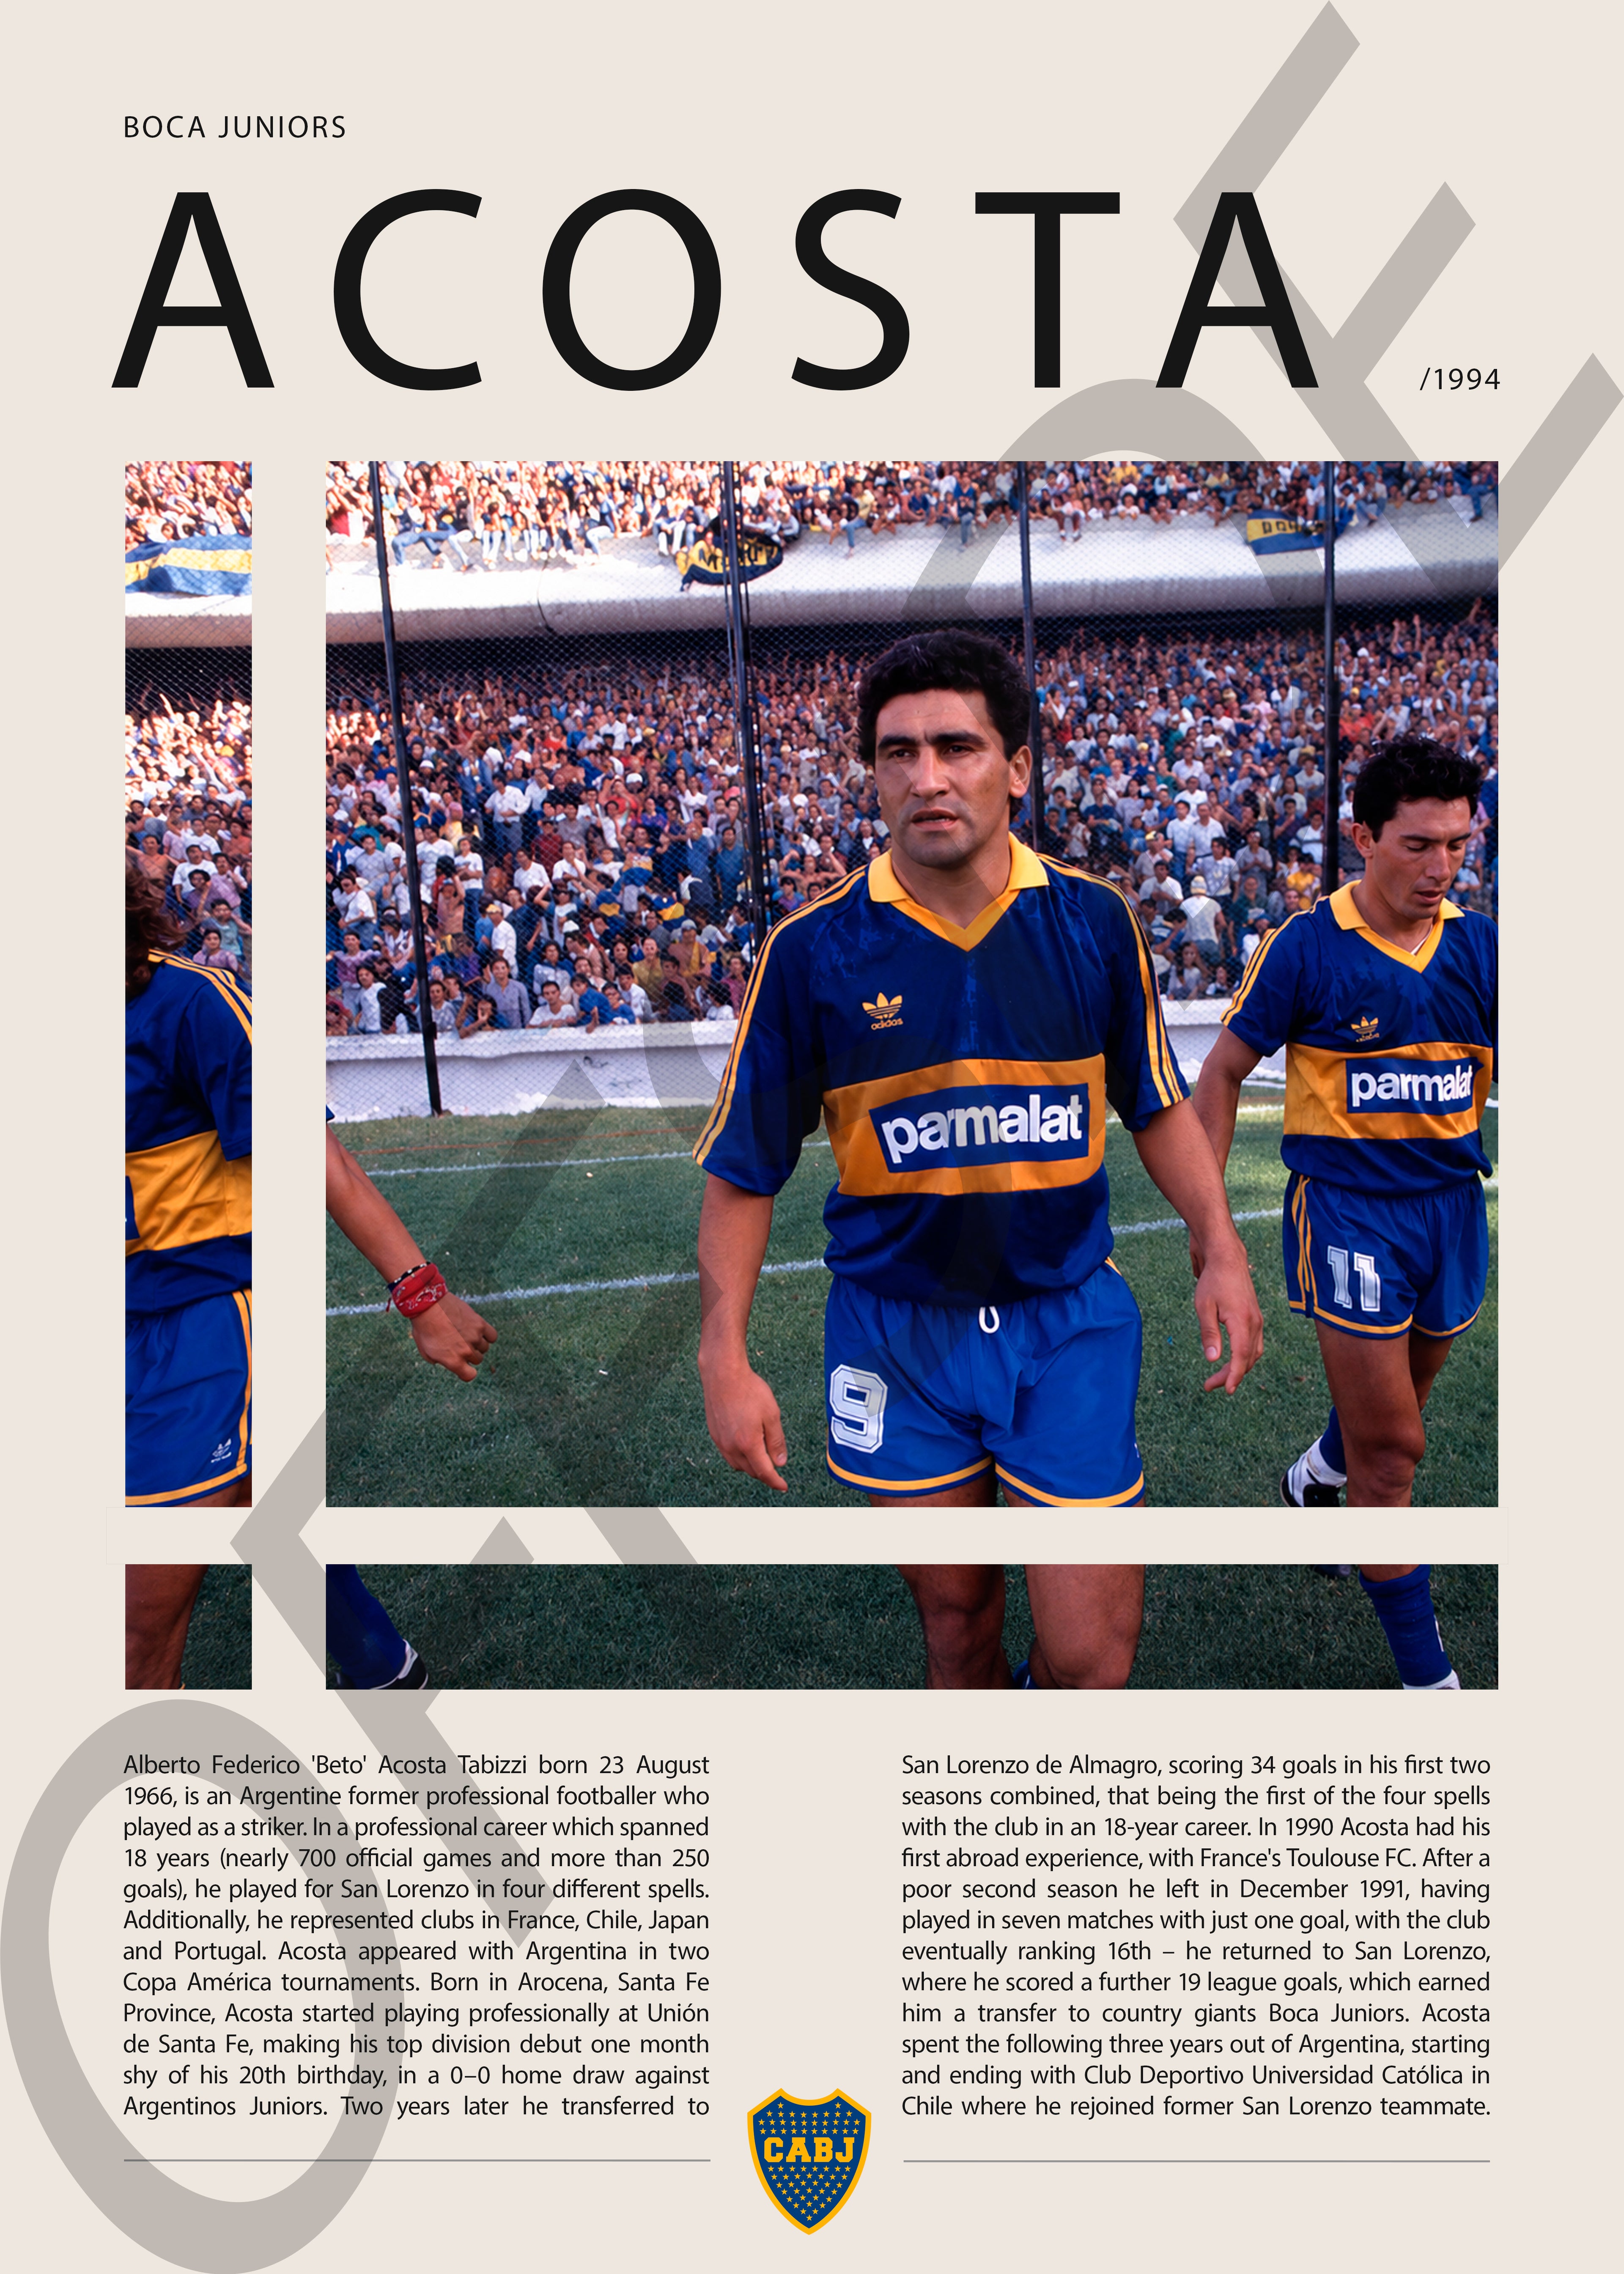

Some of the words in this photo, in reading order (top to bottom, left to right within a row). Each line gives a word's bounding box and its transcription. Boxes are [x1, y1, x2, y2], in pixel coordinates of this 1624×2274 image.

[125, 115, 206, 138] BOCA
[218, 115, 345, 138] JUNIORS
[111, 189, 1319, 391] ACOSTA
[1420, 367, 1500, 390] /1994
[1351, 1064, 1473, 1108] parmalat
[881, 1094, 1083, 1164] parmalat
[1327, 1245, 1381, 1312] 11
[829, 1364, 889, 1454] 9
[123, 1754, 200, 1774] Alberto
[213, 1754, 300, 1774] Federico
[312, 1755, 366, 1774] 'Beto'
[378, 1755, 446, 1774] Acosta
[457, 1754, 526, 1774] Tabizzi
[540, 1754, 587, 1774] born
[600, 1756, 624, 1774] 23
[636, 1755, 710, 1779] August
[903, 1755, 938, 1774] San
[947, 1755, 1029, 1774] Lorenzo
[1036, 1754, 1062, 1774] de
[1069, 1754, 1162, 1779] Almagro,
[1169, 1755, 1243, 1779] scoring
[1251, 1756, 1276, 1774] 34
[1283, 1754, 1336, 1779] goals
[1344, 1755, 1361, 1774] in
[1370, 1754, 1397, 1774] his
[1405, 1754, 1443, 1774] first
[1450, 1757, 1490, 1774] two
[125, 1787, 177, 1807] 1966,
[185, 1786, 199, 1805] is
[207, 1791, 231, 1805] an
[239, 1786, 341, 1810] Argentine
[348, 1785, 419, 1805] former
[427, 1785, 549, 1810] professional
[557, 1785, 656, 1805] footballer
[664, 1785, 709, 1805] who
[902, 1791, 982, 1805] seasons
[990, 1785, 1100, 1807] combined,
[1108, 1785, 1149, 1805] that
[1158, 1785, 1215, 1810] being
[1224, 1785, 1259, 1805] the
[1266, 1785, 1306, 1805] first
[1314, 1785, 1336, 1805] of
[1341, 1785, 1375, 1805] the
[1383, 1785, 1426, 1805] four
[1434, 1785, 1490, 1810] spells
[125, 1849, 146, 1867] 18
[156, 1853, 209, 1872] years
[220, 1847, 289, 1872] (nearly
[299, 1849, 336, 1867] 700
[346, 1847, 412, 1867] official
[423, 1853, 491, 1872] games
[501, 1847, 540, 1867] and
[551, 1853, 605, 1867] more
[615, 1847, 661, 1867] than
[672, 1849, 709, 1867] 250
[902, 1847, 940, 1867] first
[946, 1847, 1018, 1867] abroad
[1026, 1848, 1143, 1872] experience,
[1149, 1847, 1193, 1867] with
[1201, 1848, 1281, 1867] France's
[1286, 1847, 1379, 1867] Toulouse
[1386, 1848, 1416, 1867] FC.
[1422, 1847, 1473, 1867] After
[1479, 1853, 1490, 1867] a
[123, 1878, 187, 1903] goals),
[196, 1878, 221, 1898] he
[230, 1878, 296, 1903] played
[304, 1878, 334, 1898] for
[341, 1879, 377, 1898] San
[387, 1879, 469, 1898] Lorenzo
[477, 1879, 494, 1898] in
[502, 1878, 545, 1898] four
[553, 1878, 640, 1898] different
[648, 1878, 709, 1903] spells.
[903, 1884, 952, 1903] poor
[963, 1878, 1035, 1898] second
[1048, 1884, 1117, 1898] season
[1130, 1878, 1155, 1898] he
[1167, 1878, 1199, 1898] left
[1211, 1879, 1228, 1898] in
[1241, 1878, 1348, 1898] December
[1361, 1880, 1410, 1900] 1991,
[1422, 1878, 1490, 1903] having
[903, 1909, 970, 1934] played
[978, 1910, 995, 1929] in
[1002, 1915, 1060, 1929] seven
[1068, 1909, 1153, 1929] matches
[1160, 1909, 1204, 1929] with
[1210, 1910, 1248, 1934] just
[1255, 1915, 1294, 1929] one
[1300, 1909, 1349, 1934] goal,
[1355, 1909, 1399, 1929] with
[1407, 1909, 1440, 1929] the
[1447, 1909, 1490, 1929] club
[123, 1940, 162, 1960] and
[175, 1940, 266, 1965] Portugal.
[278, 1941, 346, 1960] Acosta
[359, 1940, 456, 1965] appeared
[468, 1940, 513, 1960] with
[526, 1941, 626, 1965] Argentina
[639, 1941, 656, 1960] in
[669, 1943, 709, 1960] two
[124, 2003, 215, 2024] Province,
[225, 2003, 292, 2022] Acosta
[303, 2002, 374, 2022] started
[385, 2002, 459, 2027] playing
[469, 2002, 610, 2027] professionally
[619, 2005, 638, 2022] at
[648, 2003, 708, 2022] Unión
[903, 2002, 941, 2022] him
[954, 2008, 965, 2022] a
[978, 2002, 1057, 2022] transfer
[1068, 2005, 1090, 2022] to
[1103, 2005, 1182, 2027] country
[1195, 2003, 1256, 2027] giants
[1270, 2003, 1318, 2022] Boca
[1331, 2003, 1409, 2022] Juniors.
[1422, 2003, 1490, 2022] Acosta
[902, 2036, 959, 2058] spent
[966, 2033, 999, 2053] the
[1006, 2033, 1102, 2058] following
[1109, 2033, 1163, 2053] three
[1169, 2039, 1223, 2058] years
[1230, 2036, 1265, 2053] out
[1272, 2033, 1293, 2053] of
[1299, 2034, 1404, 2058] Argentina,
[1412, 2034, 1490, 2058] starting
[123, 2096, 236, 2120] Argentinos
[250, 2096, 327, 2115] Juniors.
[340, 2096, 383, 2115] Two
[397, 2101, 450, 2120] years
[465, 2095, 509, 2115] later
[524, 2095, 548, 2115] he
[562, 2095, 673, 2115] transferred
[688, 2098, 709, 2115] to
[902, 2095, 952, 2115] Chile
[961, 2095, 1026, 2115] where
[1036, 2095, 1061, 2115] he
[1071, 2095, 1154, 2120] rejoined
[1163, 2095, 1234, 2115] former
[1243, 2096, 1279, 2115] San
[1290, 2096, 1372, 2115] Lorenzo
[1380, 2098, 1490, 2115] teammate.
[764, 2137, 855, 2163] CABJ
